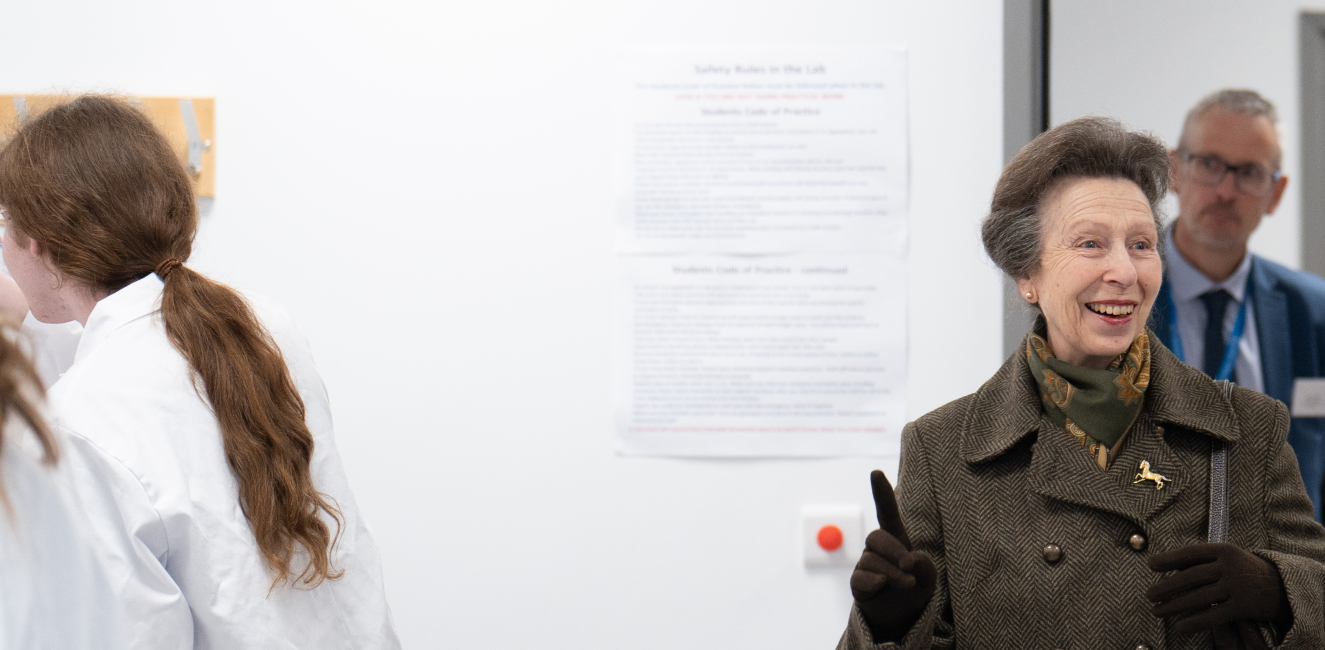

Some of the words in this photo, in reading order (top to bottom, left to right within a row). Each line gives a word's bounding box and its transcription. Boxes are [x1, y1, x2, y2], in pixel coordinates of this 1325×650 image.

[694, 64, 730, 75] Safety
[735, 64, 766, 74] Rules
[769, 64, 780, 74] in
[783, 64, 802, 74] the
[806, 64, 827, 74] Lab
[701, 107, 741, 116] Students
[745, 107, 768, 116] Code
[771, 107, 781, 116] of
[783, 107, 821, 116] Practice
[672, 265, 713, 274] Students
[716, 265, 739, 274] Code
[742, 265, 752, 274] of
[755, 265, 792, 274] Practice
[801, 265, 848, 274] continued
